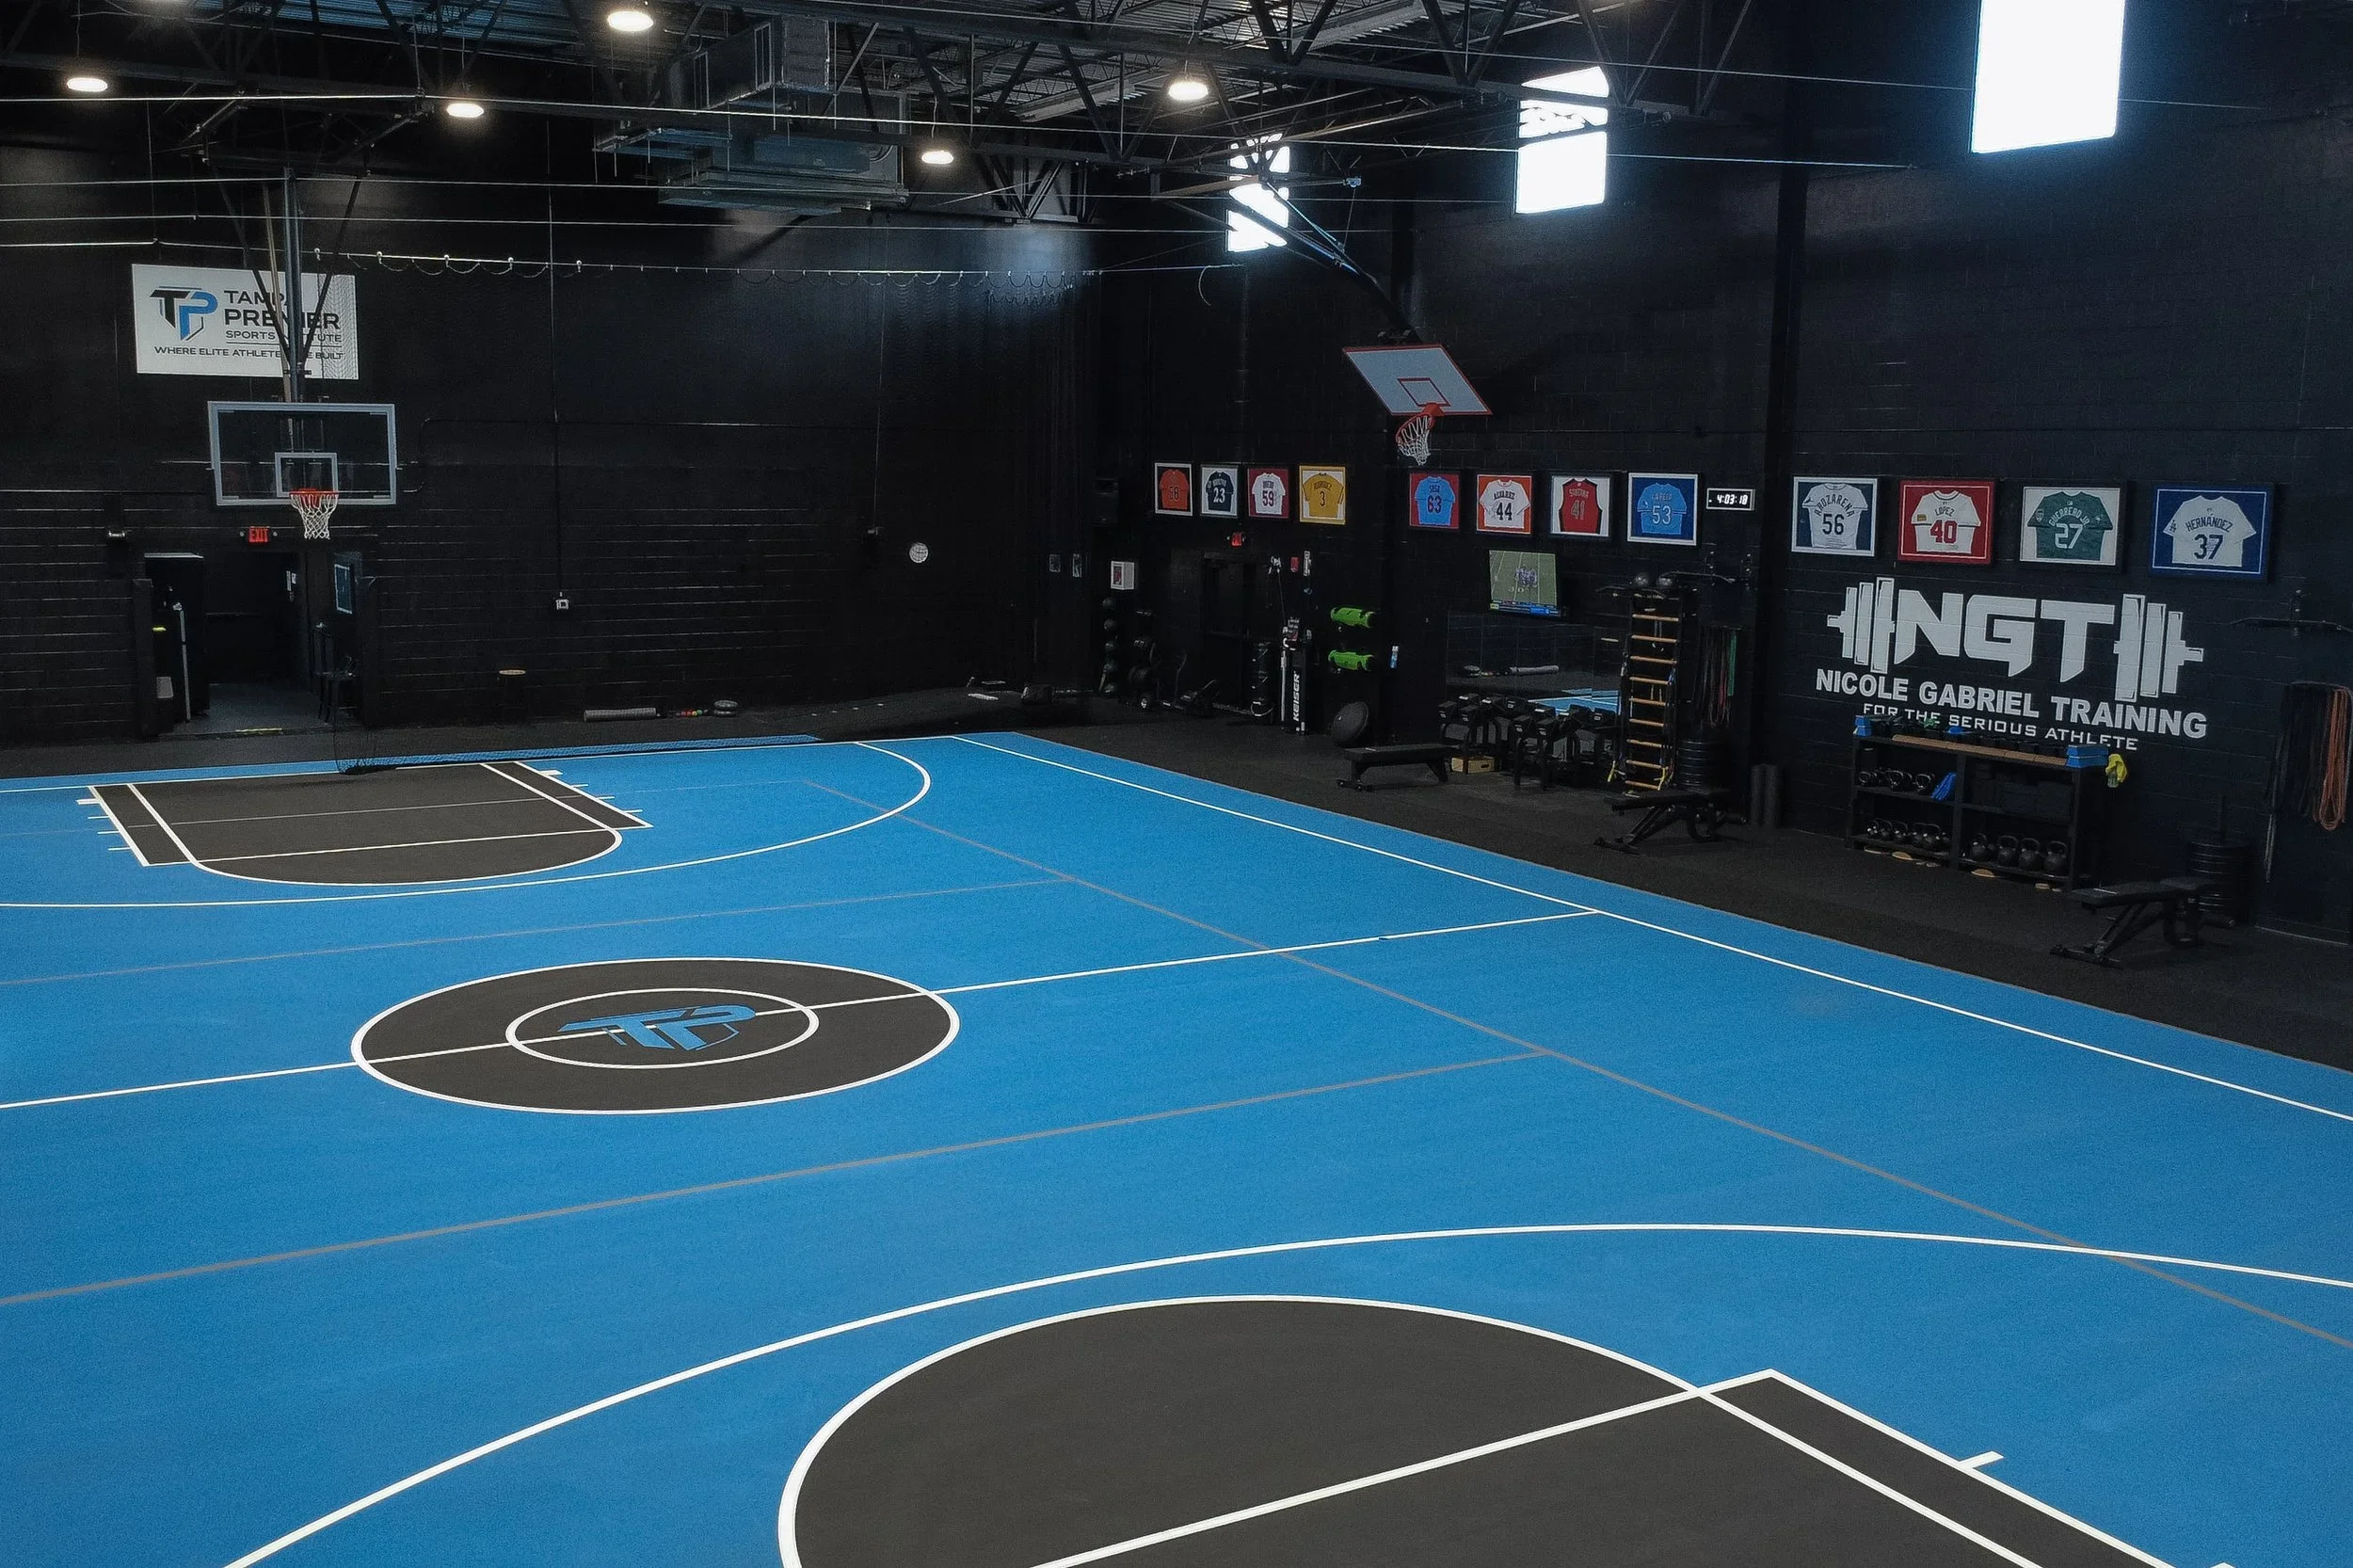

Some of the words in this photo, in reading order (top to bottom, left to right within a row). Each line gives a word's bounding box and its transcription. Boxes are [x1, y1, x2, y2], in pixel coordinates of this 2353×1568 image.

[224, 290, 291, 306] TAMP
[226, 330, 276, 340] SPORTS
[154, 346, 196, 355] WHERE
[199, 348, 229, 357] ELITE
[232, 349, 283, 358] ATHLETE
[315, 351, 344, 360] BUILT
[1213, 487, 1225, 504] 23
[1262, 490, 1274, 507] 59
[1320, 490, 1325, 506] 3
[1427, 494, 1442, 513] 63
[1493, 489, 1516, 500] ALVAREZ
[1496, 502, 1513, 520] 44
[1815, 493, 1855, 517] AROZARENA
[1652, 505, 1672, 525] 53
[1822, 514, 1845, 535] 56
[2049, 507, 2083, 526] GUERRERO
[249, 528, 268, 542] EXIT
[1930, 520, 1958, 544] 40
[2054, 523, 2083, 549] 27
[2194, 534, 2224, 559] 37
[1894, 589, 2115, 682] NGT
[1816, 668, 1909, 702] NICOLE
[1918, 680, 2040, 718] GABRIEL
[2051, 696, 2207, 739] TRAINING
[1863, 703, 1898, 717] FOR
[1905, 709, 1941, 724] THE
[1948, 714, 2037, 737] SERIOUS
[2045, 728, 2138, 751] ATHLETE
